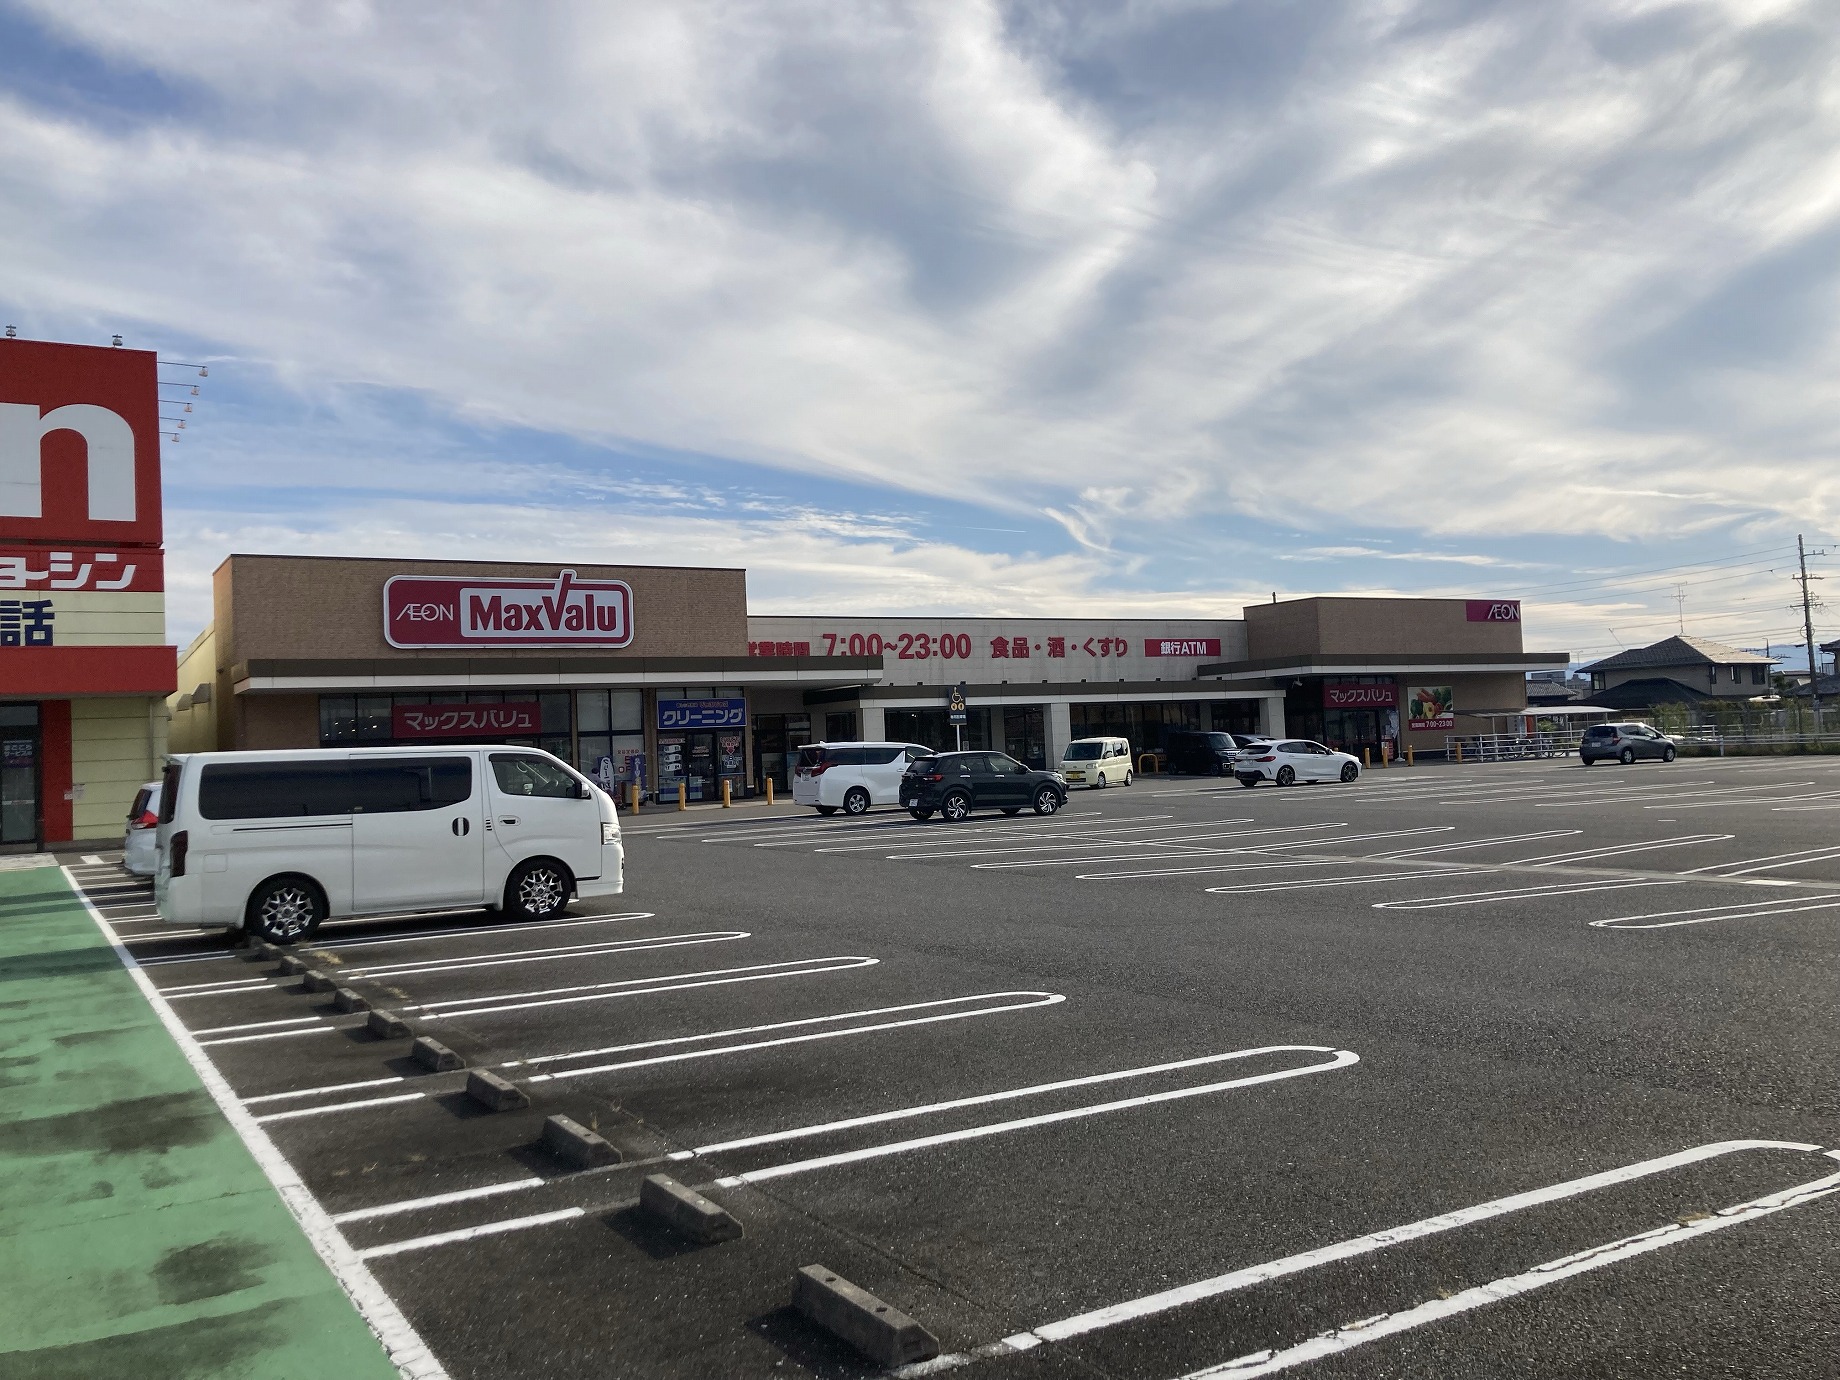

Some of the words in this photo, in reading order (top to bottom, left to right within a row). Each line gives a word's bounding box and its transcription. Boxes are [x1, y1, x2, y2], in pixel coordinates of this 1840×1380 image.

[469, 573, 617, 632] MaxValu
[0, 599, 55, 646] 話
[1160, 641, 1207, 656] 銀行ATM
[1330, 689, 1393, 703] マックスバリュ
[404, 709, 532, 731] マックスバリュ
[663, 709, 743, 725] クリーニング
